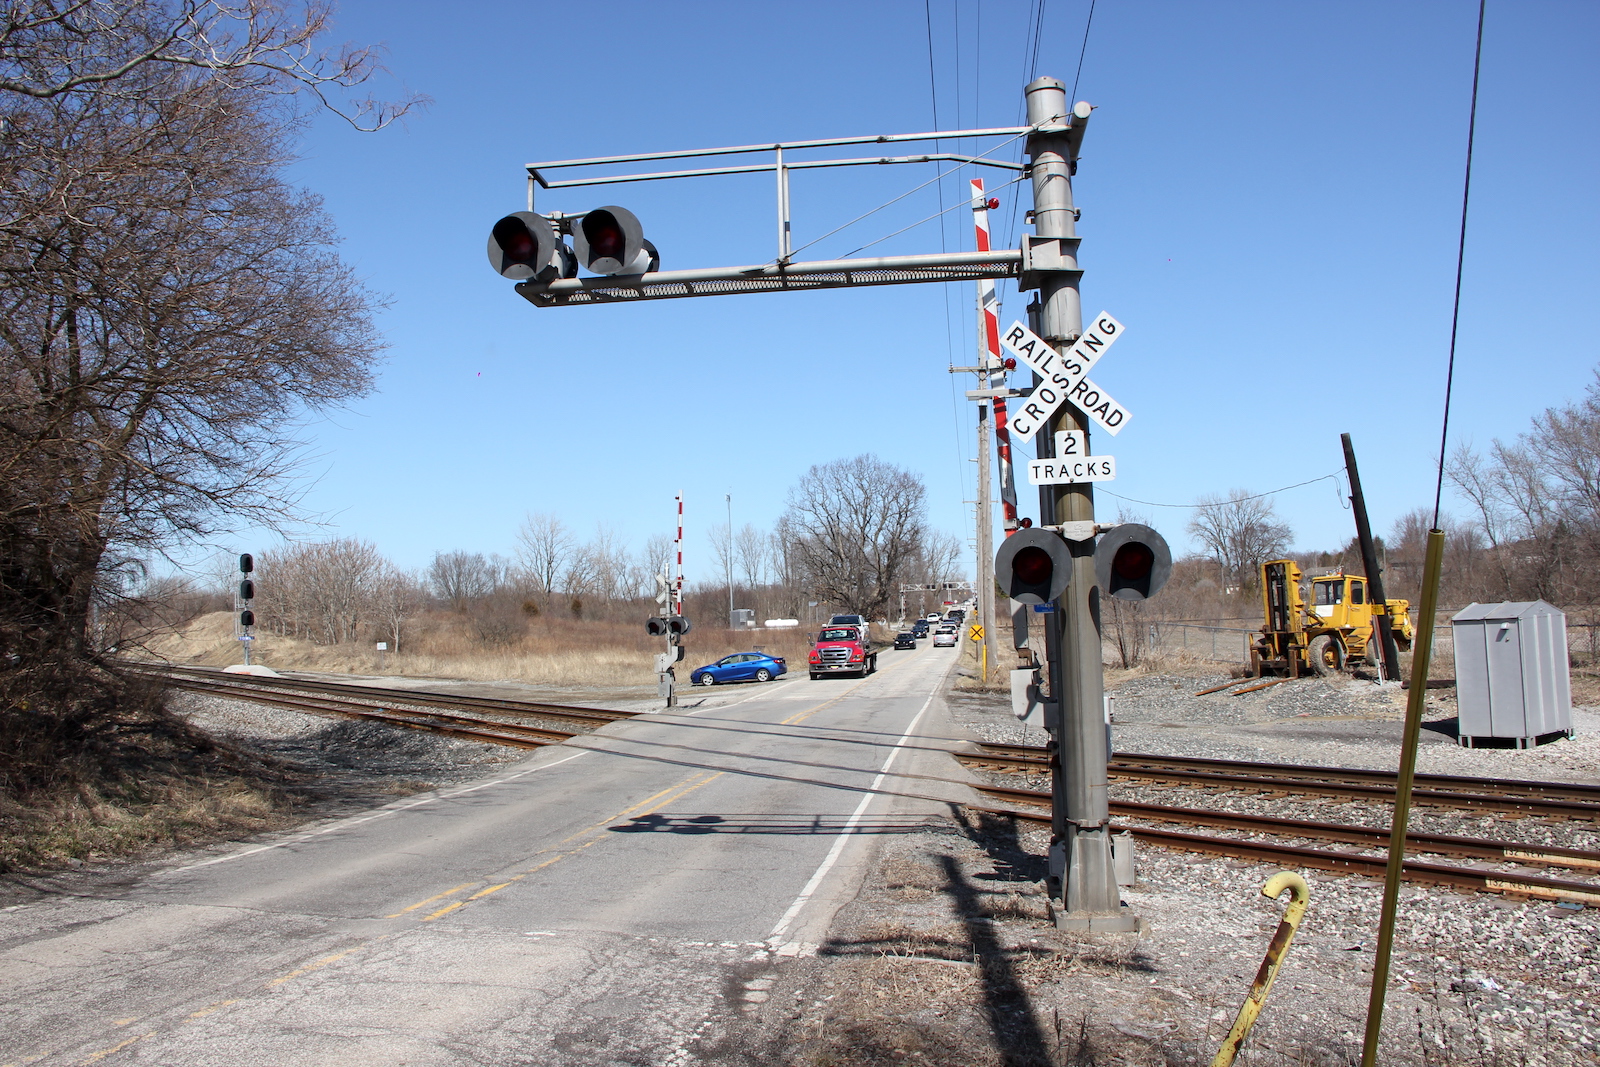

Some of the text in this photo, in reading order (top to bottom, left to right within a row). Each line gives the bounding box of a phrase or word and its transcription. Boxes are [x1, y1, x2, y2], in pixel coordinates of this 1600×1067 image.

[1006, 326, 1123, 427] RAIL ROAD
[1013, 318, 1116, 434] CROSSING
[1032, 461, 1111, 479] TRACKS
[1064, 437, 1076, 455] 2
